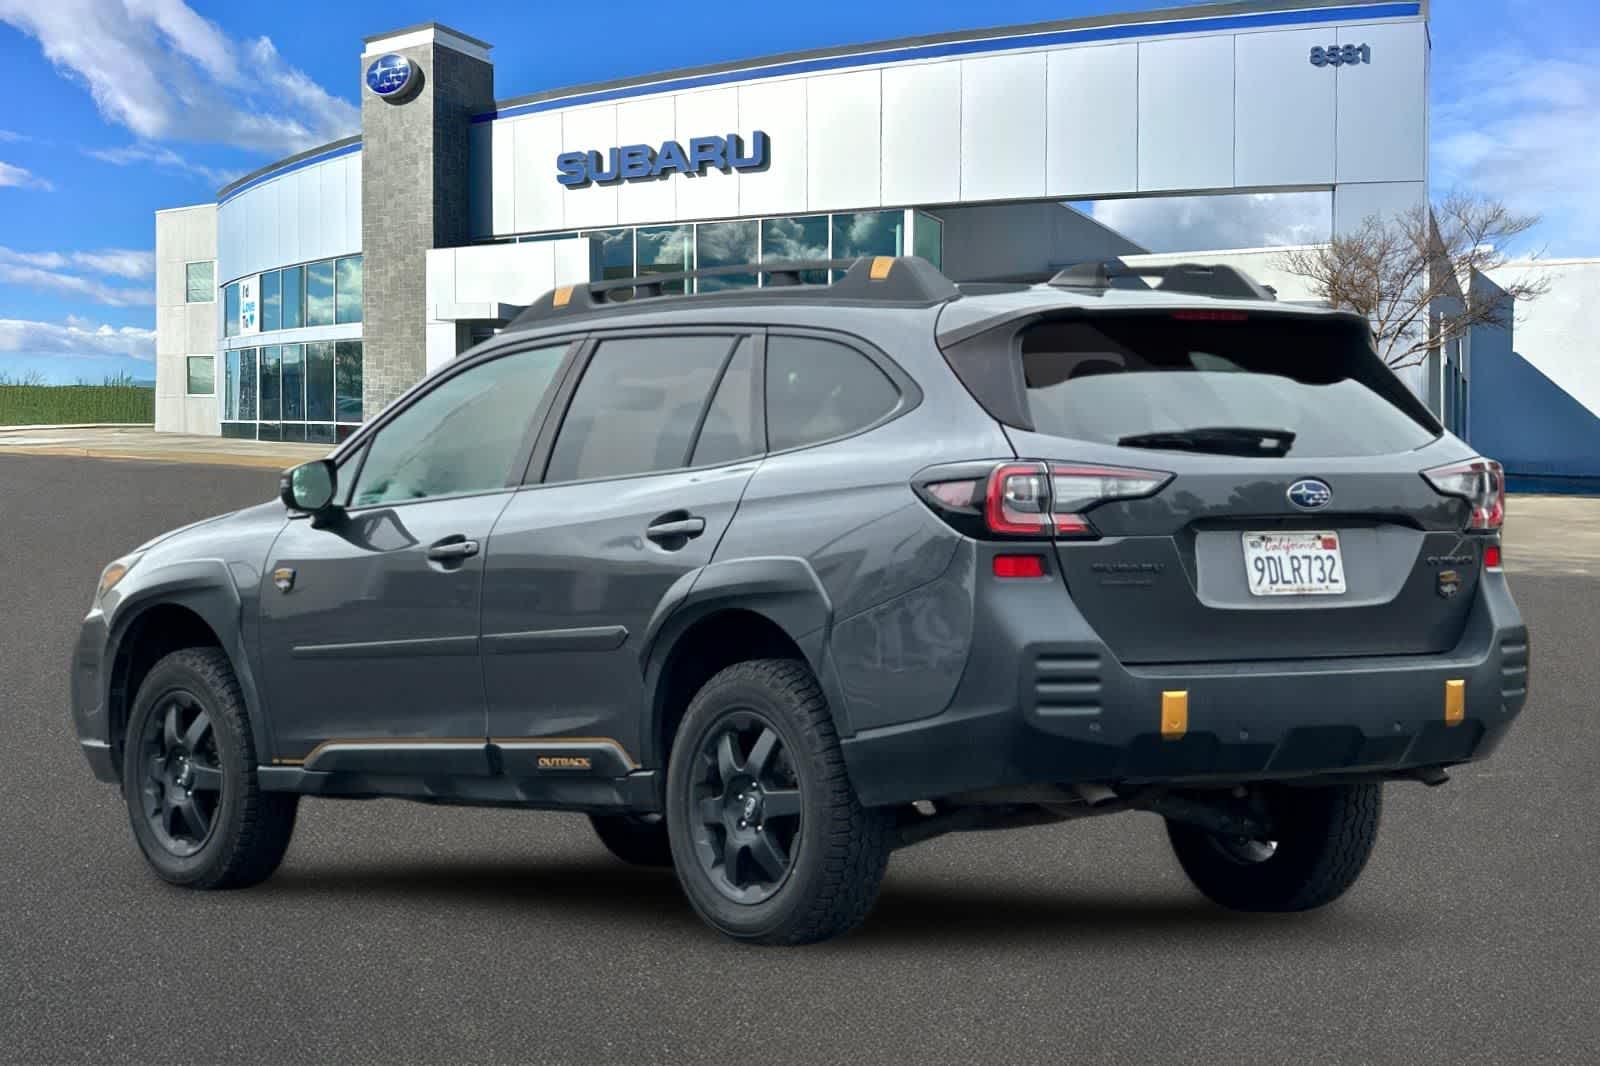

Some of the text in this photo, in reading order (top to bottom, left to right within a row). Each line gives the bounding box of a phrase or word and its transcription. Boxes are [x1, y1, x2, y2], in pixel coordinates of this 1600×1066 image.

[556, 129, 770, 190] SUBARU
[1264, 536, 1317, 554] California
[1253, 554, 1340, 587] 9DLR732
[537, 757, 592, 770] OUTBACK
